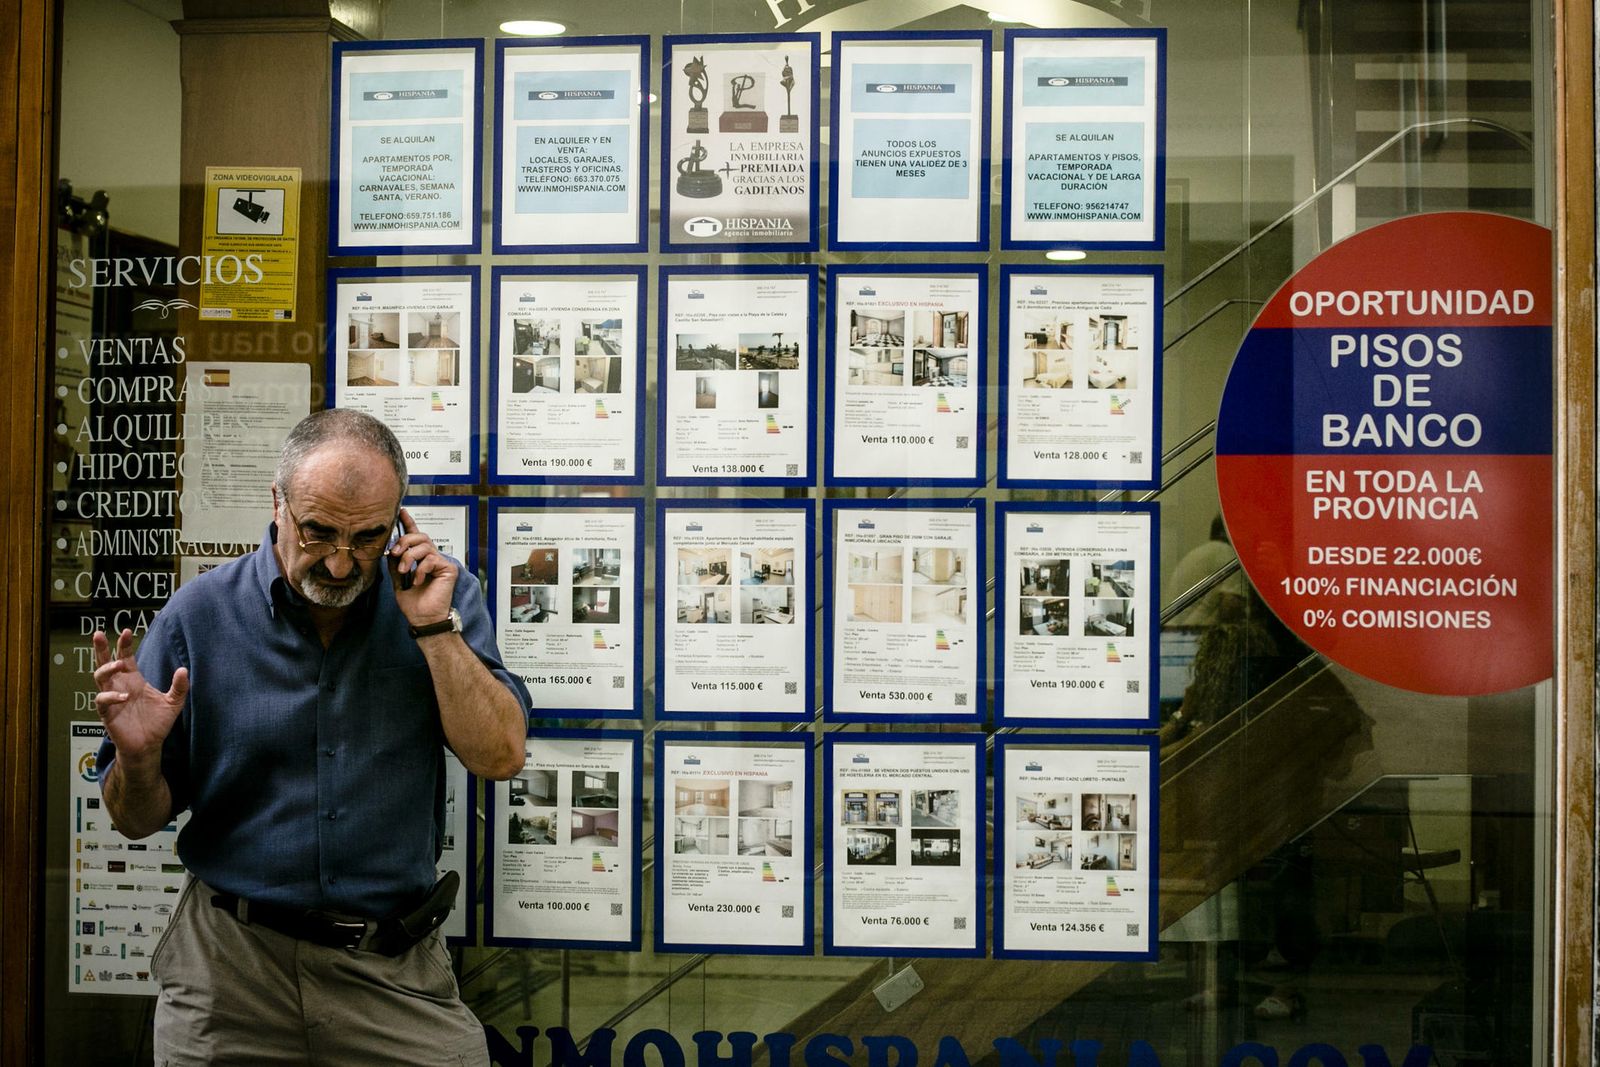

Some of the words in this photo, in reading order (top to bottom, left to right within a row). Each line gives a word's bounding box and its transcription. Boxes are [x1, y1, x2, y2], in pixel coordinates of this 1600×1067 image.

[564, 90, 602, 98] HISPANIA
[380, 136, 392, 144] SE
[393, 136, 435, 144] ALQUILAN
[534, 137, 546, 145] EN
[548, 136, 590, 144] ALQUILER
[592, 136, 598, 144] Y
[600, 136, 612, 144] EN
[1055, 134, 1067, 142] SE
[1069, 134, 1114, 142] ALQUILAN
[730, 142, 744, 152] LA
[750, 142, 804, 151] EMPRESA
[887, 140, 917, 148] TODOS
[919, 140, 937, 148] LOS
[557, 146, 588, 154] VENTA:
[861, 150, 907, 158] ANUNCIOS
[909, 150, 962, 158] EXPUESTOS
[362, 154, 431, 163] APARTAMENTOS
[529, 156, 571, 164] LOCALES,
[573, 156, 616, 164] GARAJES,
[730, 153, 804, 161] INMOBILIARIA
[1112, 153, 1141, 161] PISOS,
[381, 164, 434, 172] TEMPORADA
[740, 163, 805, 173] PREMIADA
[855, 159, 886, 167] TIENEN
[888, 160, 907, 168] UNA
[948, 160, 960, 168] DE
[962, 160, 968, 168] 3
[1057, 163, 1112, 171] TEMPORADA
[521, 166, 572, 174] TRASTEROS
[582, 165, 623, 173] OFICINAS.
[213, 174, 234, 182] ZONA
[236, 174, 294, 182] VIDEOVIGILADA
[379, 174, 435, 182] VACACIONAL:
[574, 175, 620, 183] 663.370.075
[732, 175, 774, 184] GRACIAS
[776, 176, 783, 184] A
[786, 176, 805, 184] LOS
[1028, 173, 1085, 181] VACACIONAL
[359, 184, 418, 192] CARNAVALES,
[518, 184, 626, 192] WWW.INMOHISPANIA.COM
[734, 186, 804, 195] GADITANOS
[372, 194, 403, 202] SANTA,
[404, 193, 442, 201] VERANO.
[1033, 202, 1083, 210] TELEFONO:
[1085, 202, 1129, 210] 956214747
[1027, 212, 1141, 221] WWW.INMOHISPANIA.COM
[352, 221, 460, 230] WWW.INMOHISPANIA.COM
[724, 218, 793, 229] HISPANIA
[69, 254, 263, 289] SERVICIOS
[1289, 289, 1534, 316] OPORTUNIDAD
[78, 336, 186, 366] VENTAS
[1331, 334, 1463, 368] PISOS
[78, 374, 212, 404] COMPRAS
[1373, 374, 1432, 408] DE
[76, 413, 250, 447] ALQUILERES
[1322, 413, 1482, 448] BANCO
[862, 435, 887, 443] Venta
[891, 436, 926, 444] 110.000
[928, 436, 934, 444] €
[406, 451, 421, 459] 000
[424, 451, 429, 459] €
[1034, 451, 1060, 459] Venta
[1064, 451, 1099, 460] 128.000
[1102, 452, 1108, 460] €
[78, 452, 233, 480] HIPOTECAS
[692, 465, 718, 473] Venta
[722, 465, 756, 473] 138.000
[1306, 470, 1345, 493] EN
[1354, 470, 1438, 493] TODA
[1446, 470, 1484, 493] LA
[1313, 497, 1478, 520] PROVINCIA
[1308, 547, 1387, 565] DESDE
[1393, 547, 1482, 566] 22.000€
[1281, 578, 1340, 596] 100%
[1346, 574, 1518, 596] FINANCIACIÓN
[1303, 610, 1336, 628] 0%
[1342, 610, 1491, 629] COMISIONES
[81, 616, 106, 636] DE
[521, 676, 546, 684] Venta
[549, 676, 583, 684] 165.000
[586, 676, 592, 684] €
[1030, 680, 1057, 688] Venta
[1060, 680, 1096, 688] 190.000
[1099, 680, 1104, 688] €
[691, 682, 717, 690] Venta
[720, 682, 754, 690] 115.000
[758, 682, 763, 690] €
[860, 691, 886, 699] Venta
[889, 692, 924, 700] 530.000
[518, 901, 544, 909] Venta
[547, 902, 581, 910] 100.000
[584, 903, 590, 911] €
[688, 904, 714, 912] Venta
[717, 904, 752, 913] 230.000
[755, 905, 760, 913] €
[861, 916, 888, 924] Venta
[891, 917, 921, 925] 76.000
[923, 917, 929, 925] €
[1030, 922, 1057, 931] Venta
[1060, 923, 1096, 932] 124.356
[1099, 924, 1104, 932] €
